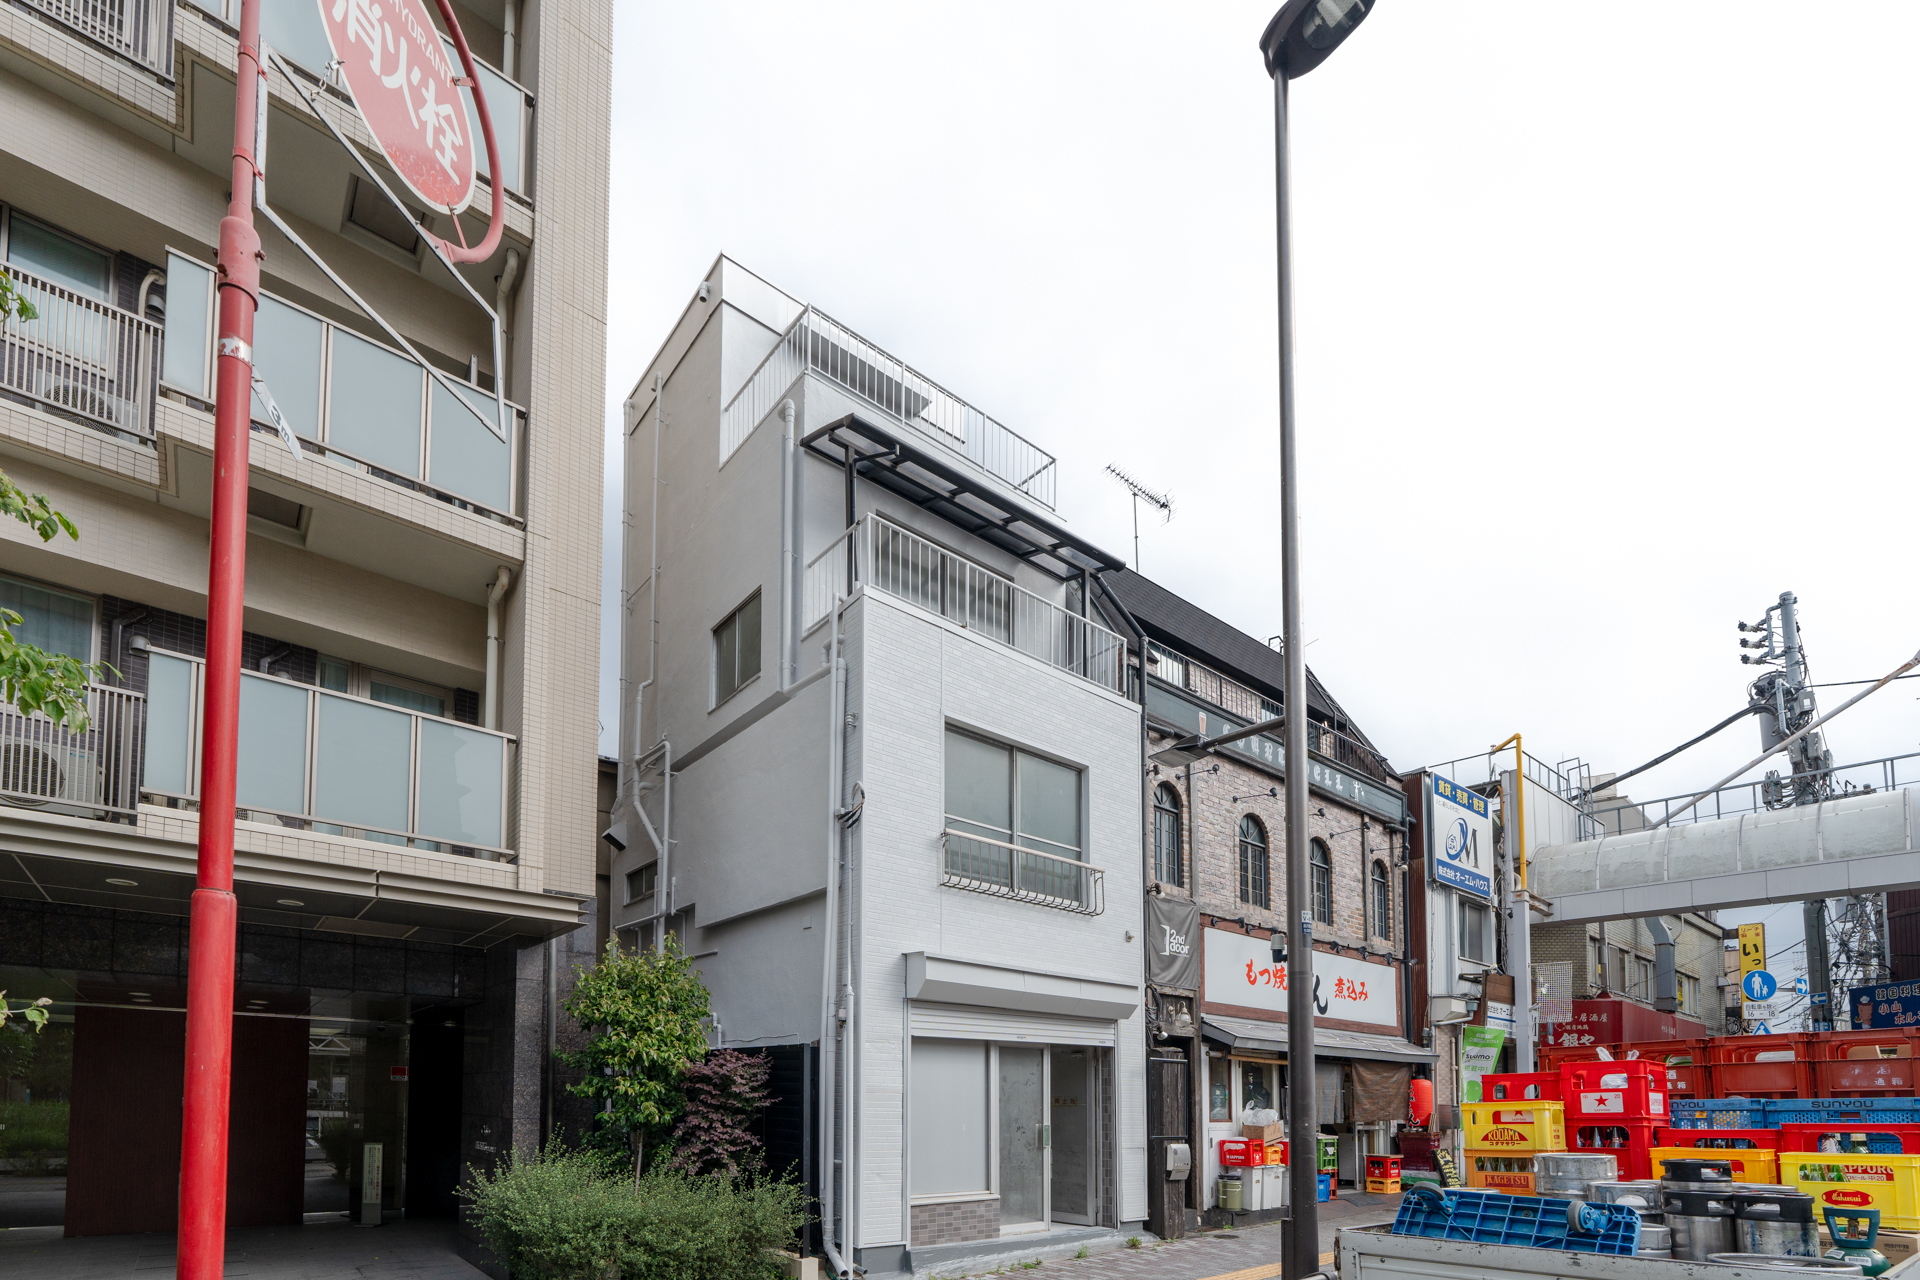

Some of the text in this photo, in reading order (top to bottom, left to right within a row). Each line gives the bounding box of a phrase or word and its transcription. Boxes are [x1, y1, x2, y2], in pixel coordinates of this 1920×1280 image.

[1170, 929, 1186, 945] 2nd
[1170, 942, 1190, 954] door
[1334, 975, 1368, 1002] 煮込み
[1768, 1010, 1776, 1018] 18
[1894, 1010, 1920, 1025] ホル
[1811, 1100, 1874, 1108] SUNYOU
[1487, 1128, 1520, 1141] KODAMA
[1486, 1174, 1527, 1185] KAGETSU
